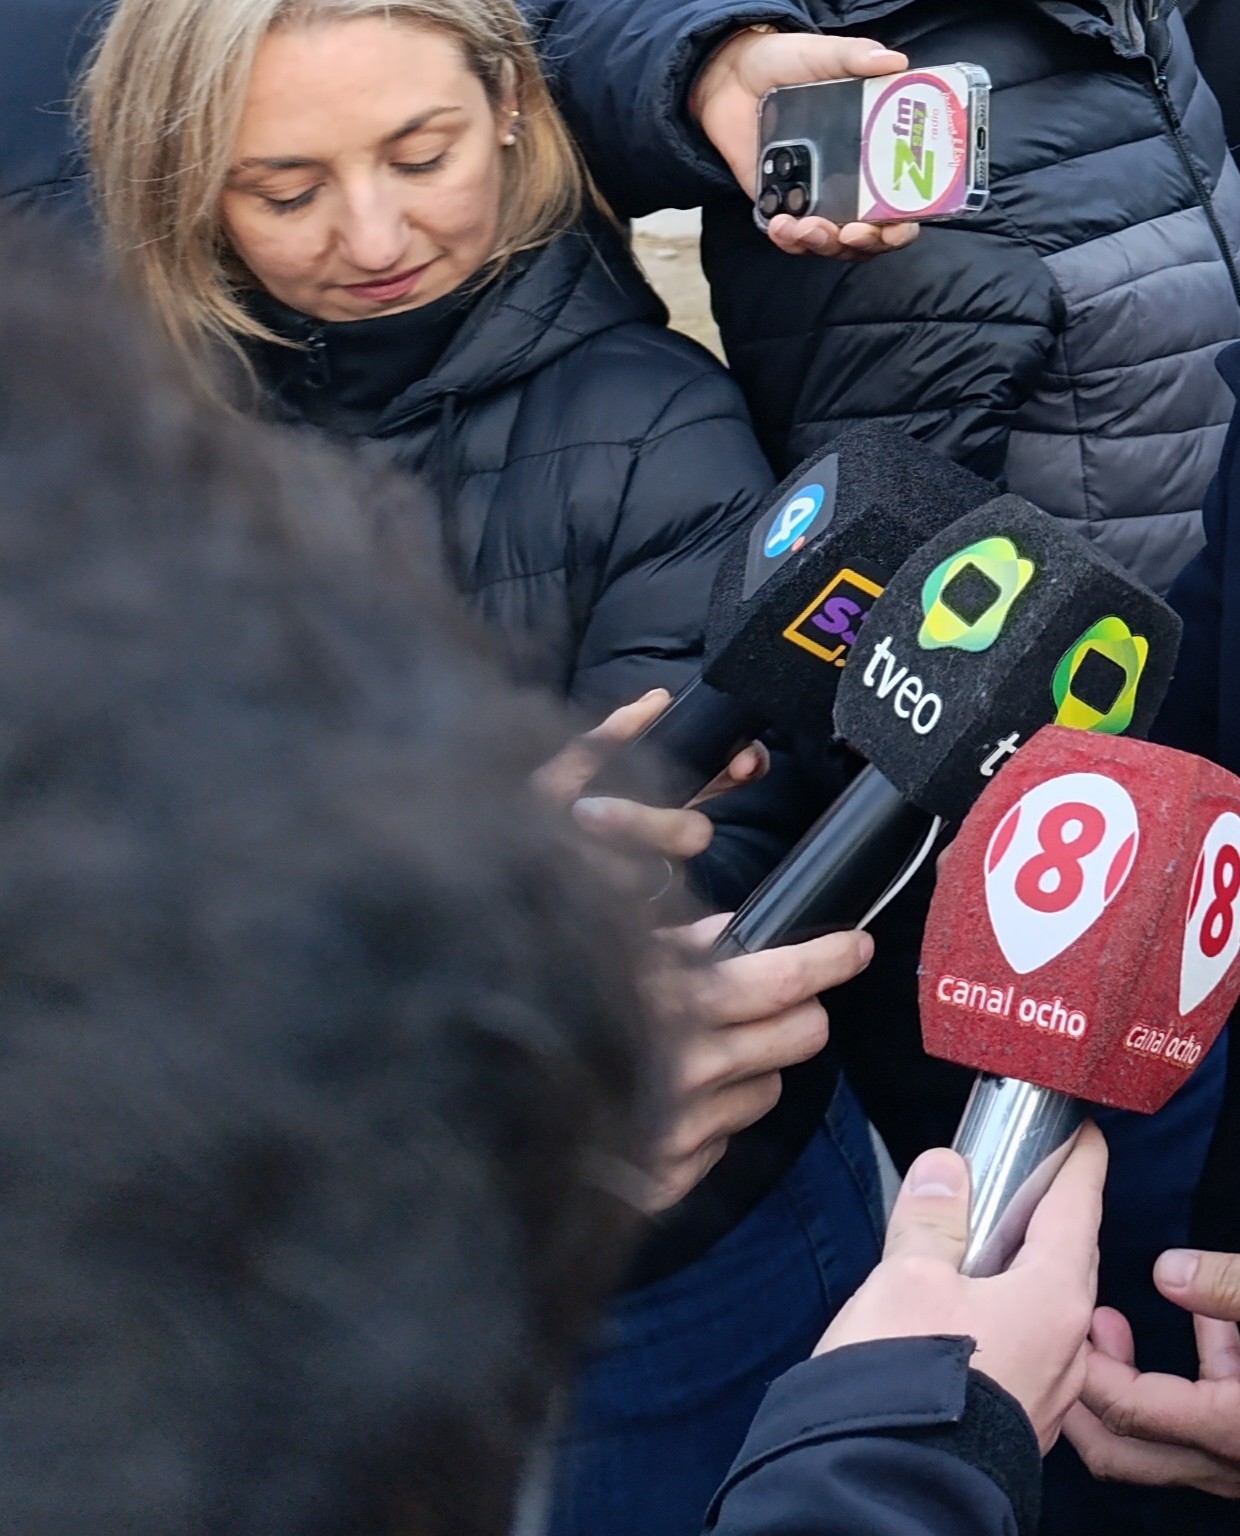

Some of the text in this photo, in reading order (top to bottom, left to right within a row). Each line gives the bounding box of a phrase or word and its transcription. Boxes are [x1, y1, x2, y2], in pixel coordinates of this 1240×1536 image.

[892, 97, 912, 136] fm
[931, 108, 940, 140] radio
[863, 636, 943, 735] tveo
[1014, 801, 1107, 914] 8
[936, 975, 1087, 1037] canal ocho
[1125, 1023, 1201, 1065] canal ocho
